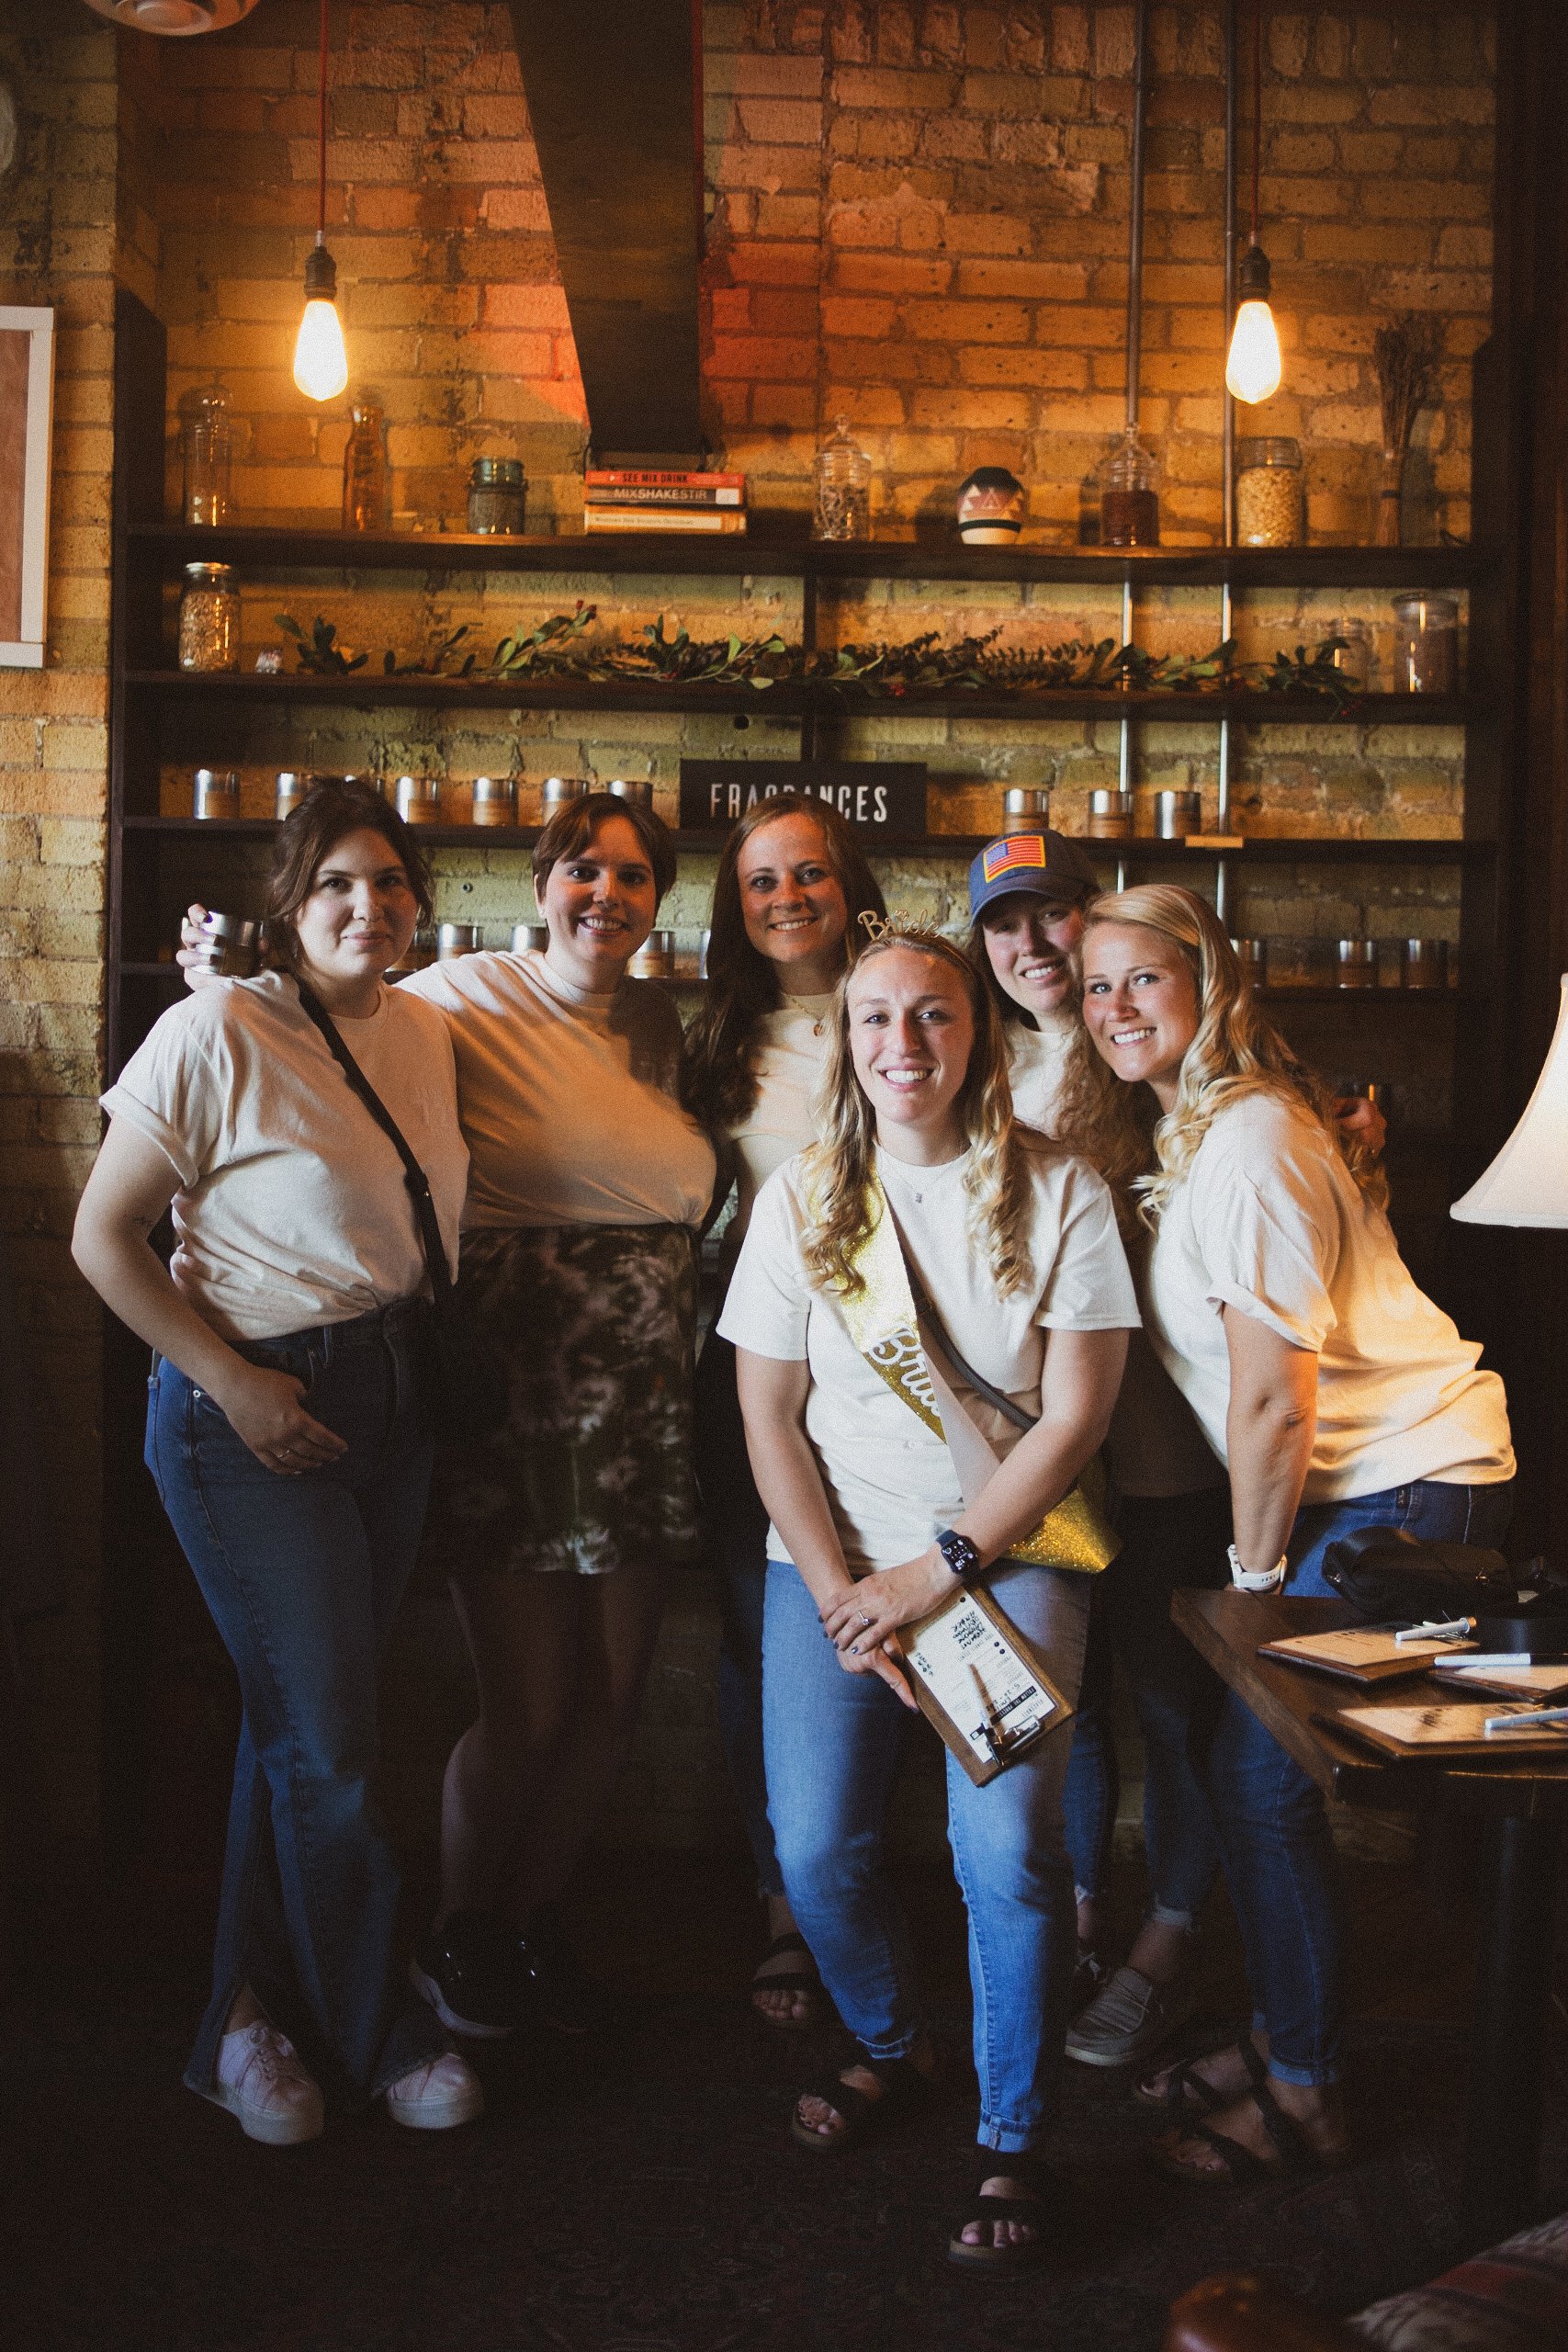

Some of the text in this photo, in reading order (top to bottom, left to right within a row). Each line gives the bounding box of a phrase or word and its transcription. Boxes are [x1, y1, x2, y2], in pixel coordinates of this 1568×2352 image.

[623, 472, 638, 482] SEE
[641, 473, 658, 482] MIX
[660, 473, 688, 483] DRINK
[710, 784, 887, 822] FRACES
[858, 910, 942, 941] Bride
